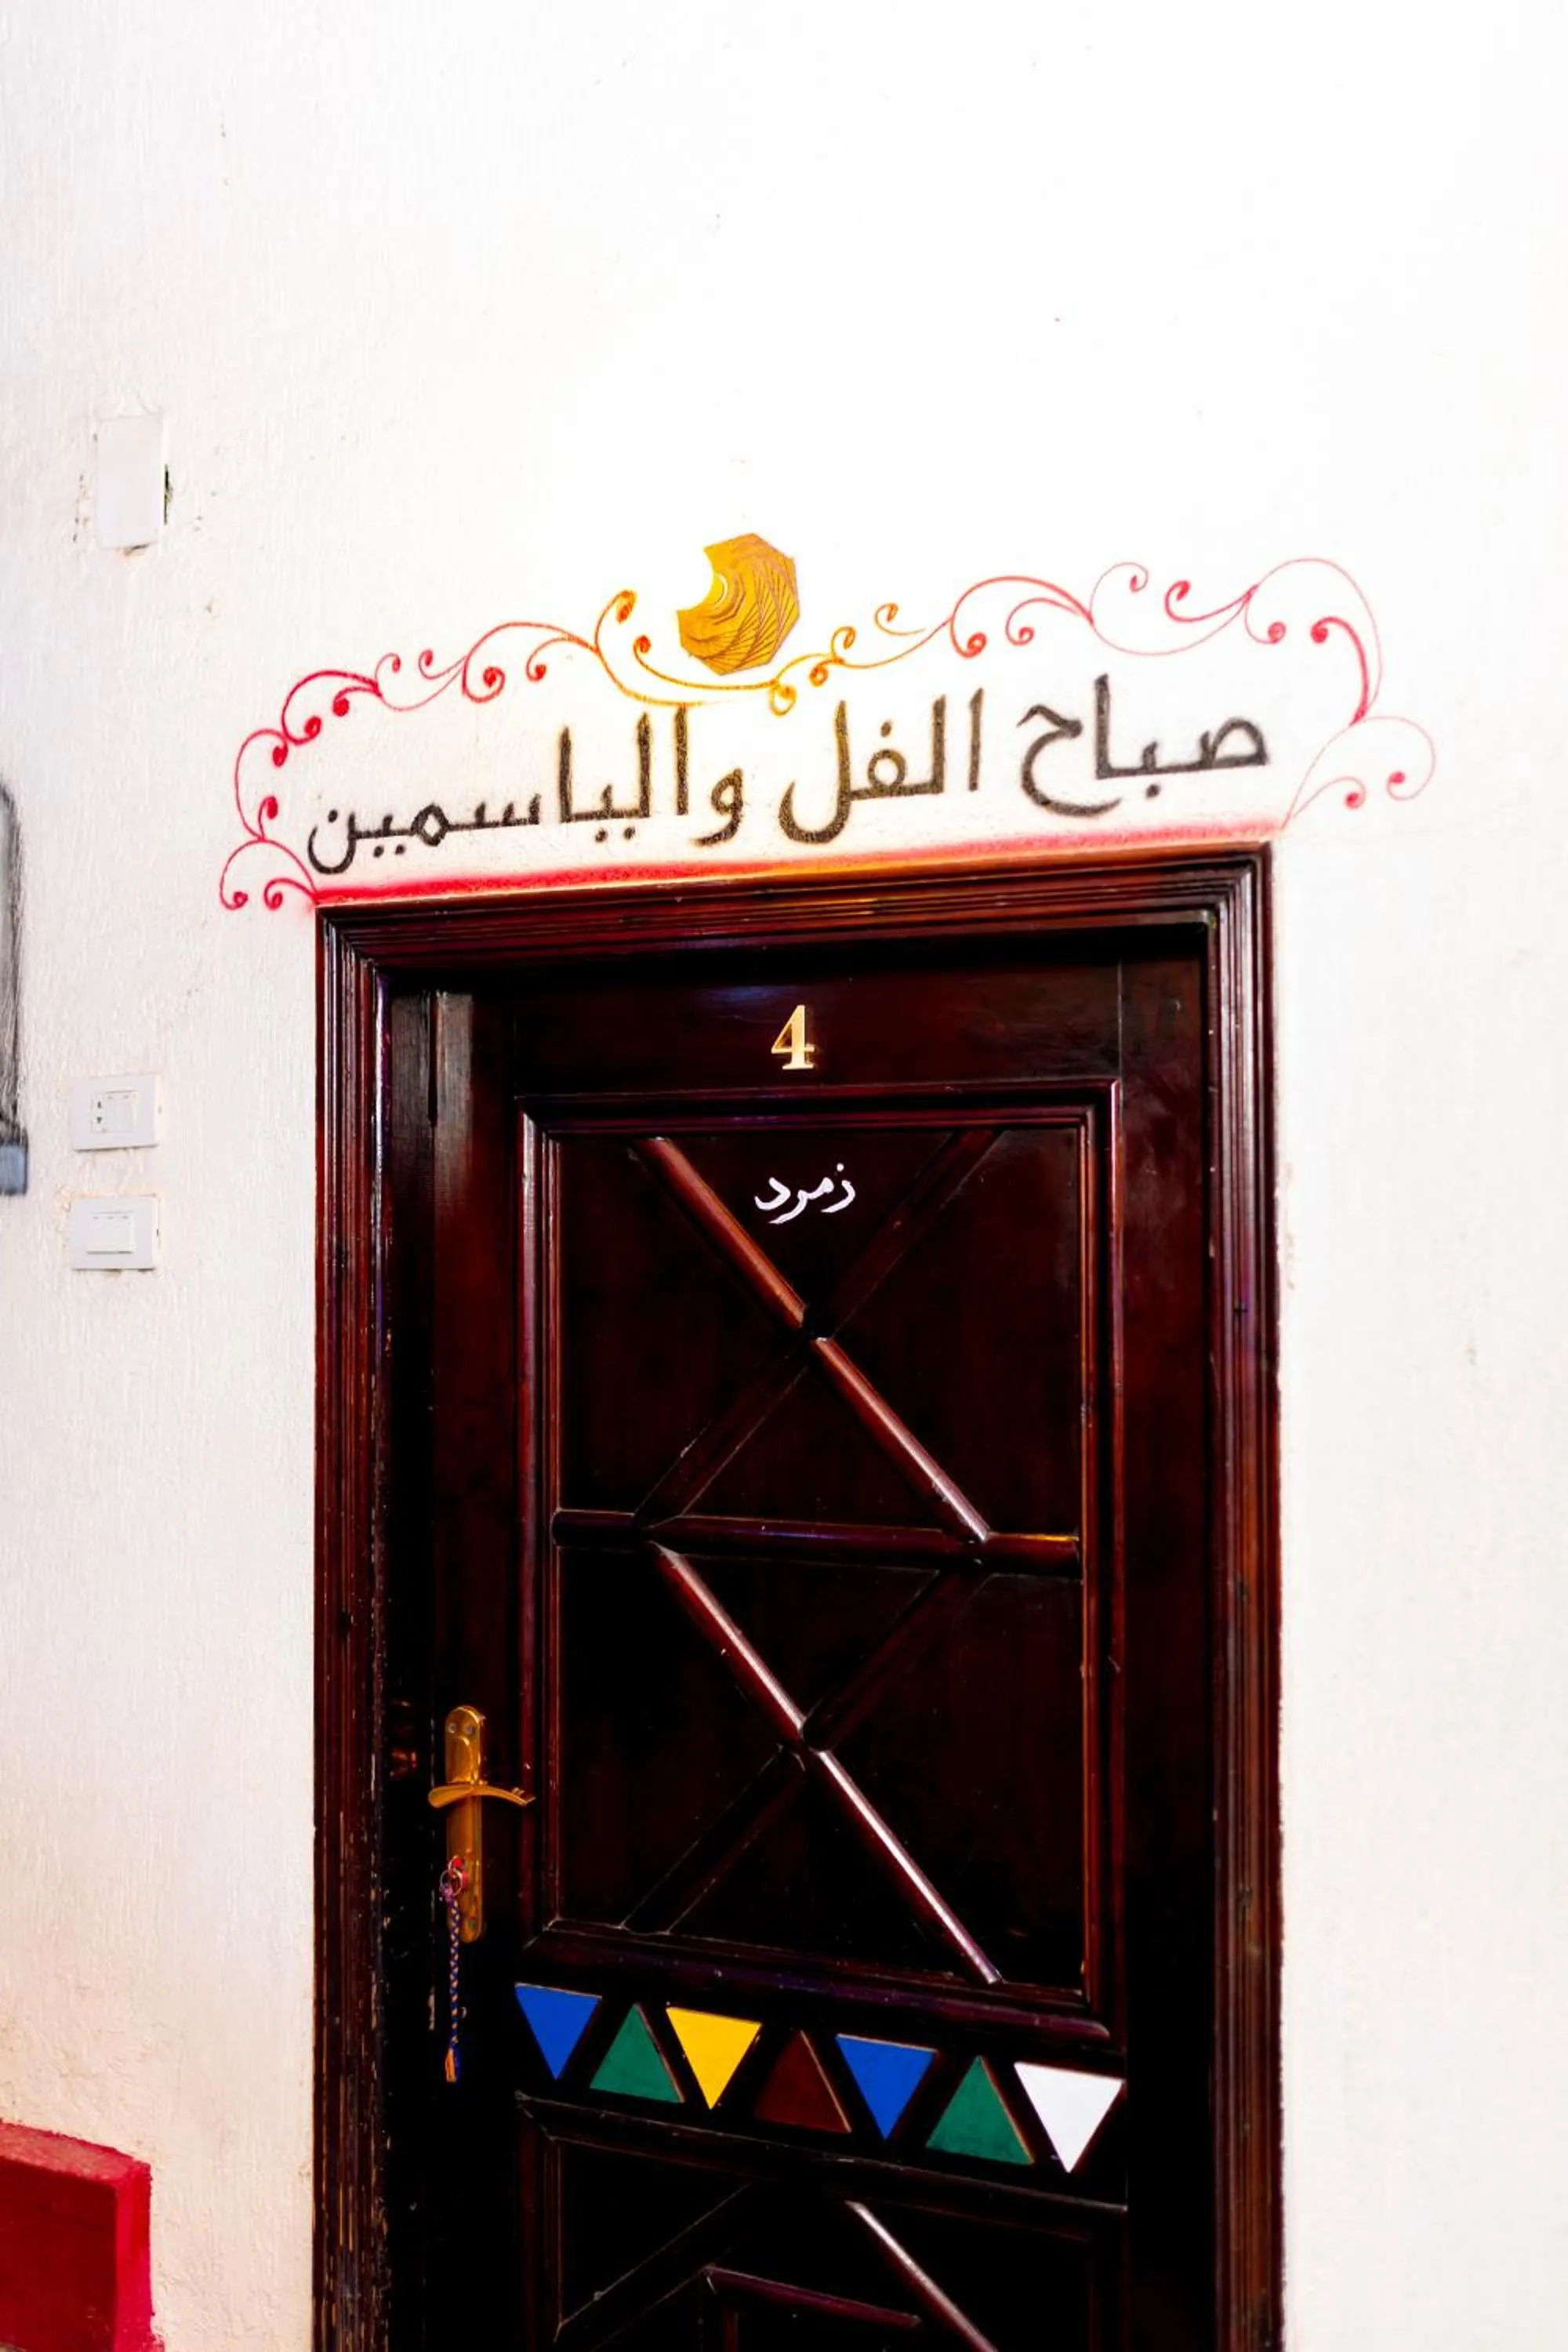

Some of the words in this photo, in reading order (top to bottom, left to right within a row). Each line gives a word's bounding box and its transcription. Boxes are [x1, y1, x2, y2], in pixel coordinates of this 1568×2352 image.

[308, 703, 743, 874] والياسمين
[779, 687, 984, 844] الفل
[1017, 673, 1269, 817] صباح
[771, 1004, 815, 1069] 4
[754, 1163, 855, 1224] زمرد
